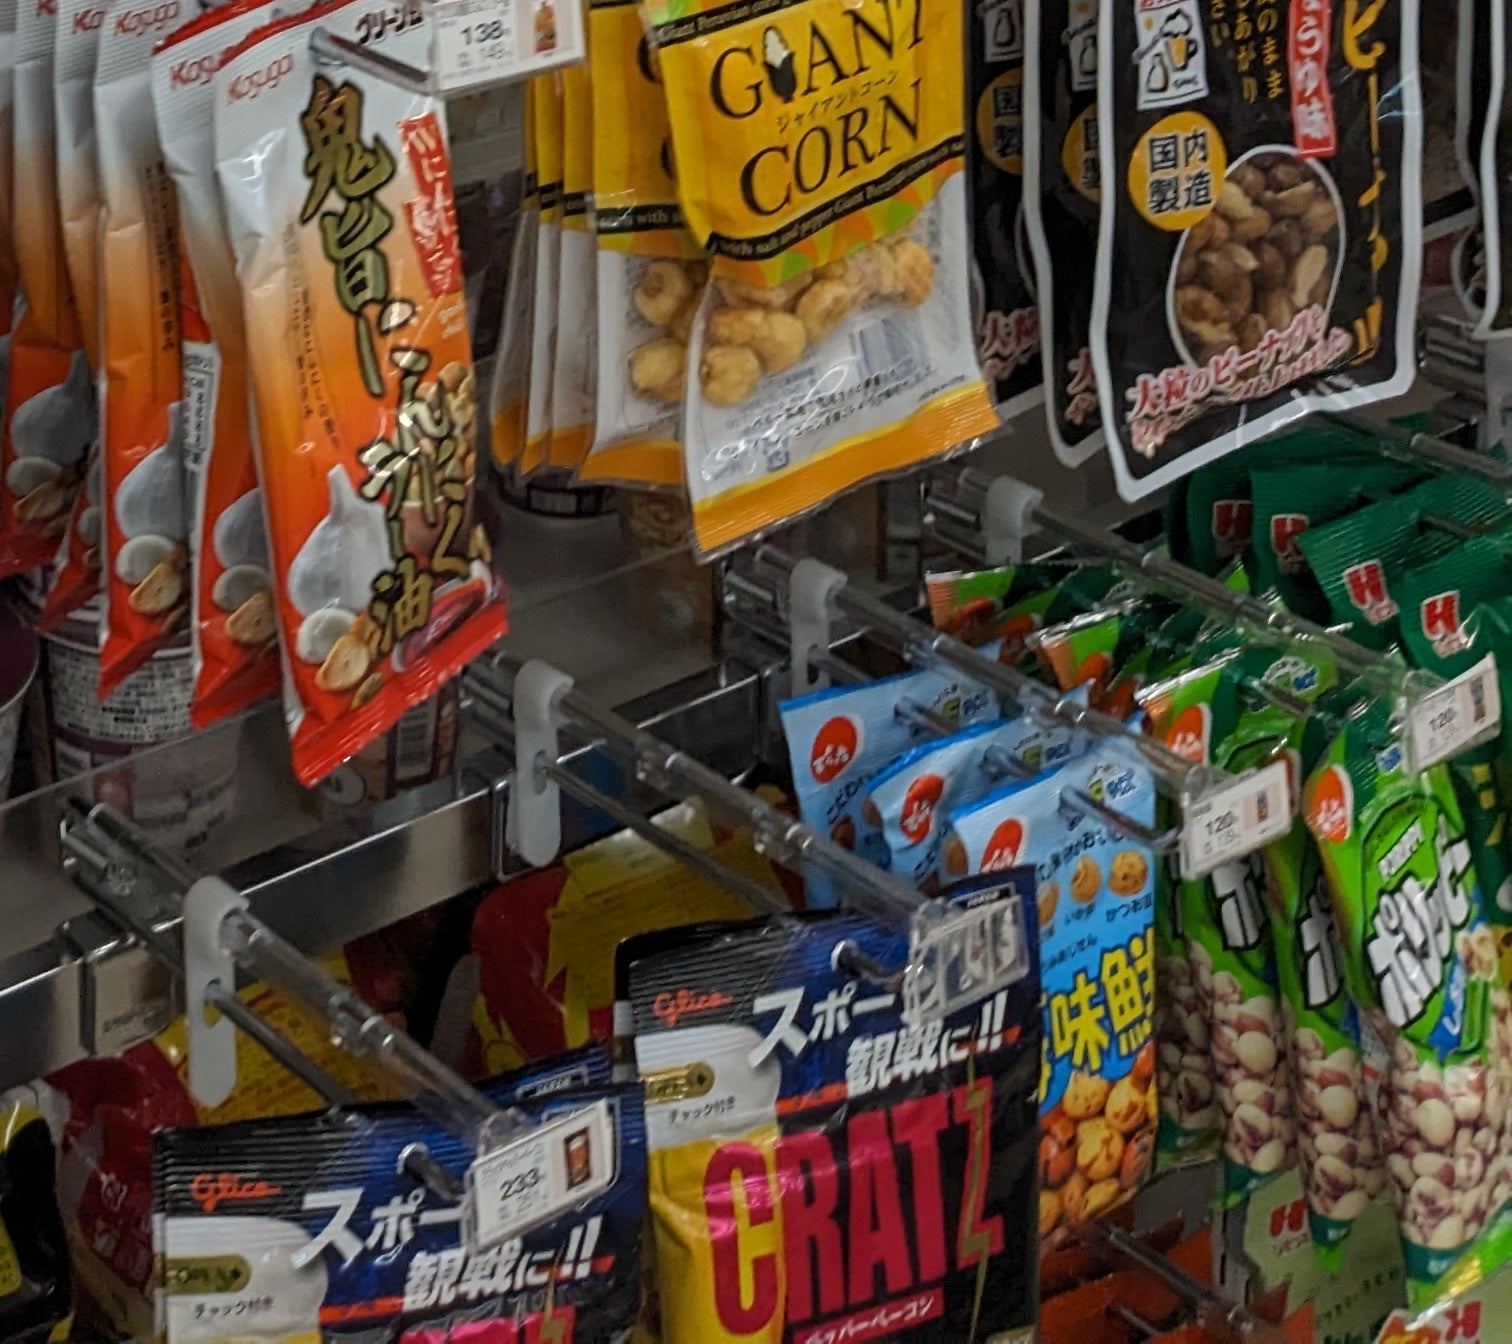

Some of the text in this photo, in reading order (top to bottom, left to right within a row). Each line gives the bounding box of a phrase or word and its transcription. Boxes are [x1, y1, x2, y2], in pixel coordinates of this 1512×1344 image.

[460, 18, 504, 46] 138
[739, 77, 923, 217] CORN
[748, 980, 895, 1069] スポー
[293, 1186, 467, 1271] スポー
[702, 1077, 1005, 1337] CRATZ
